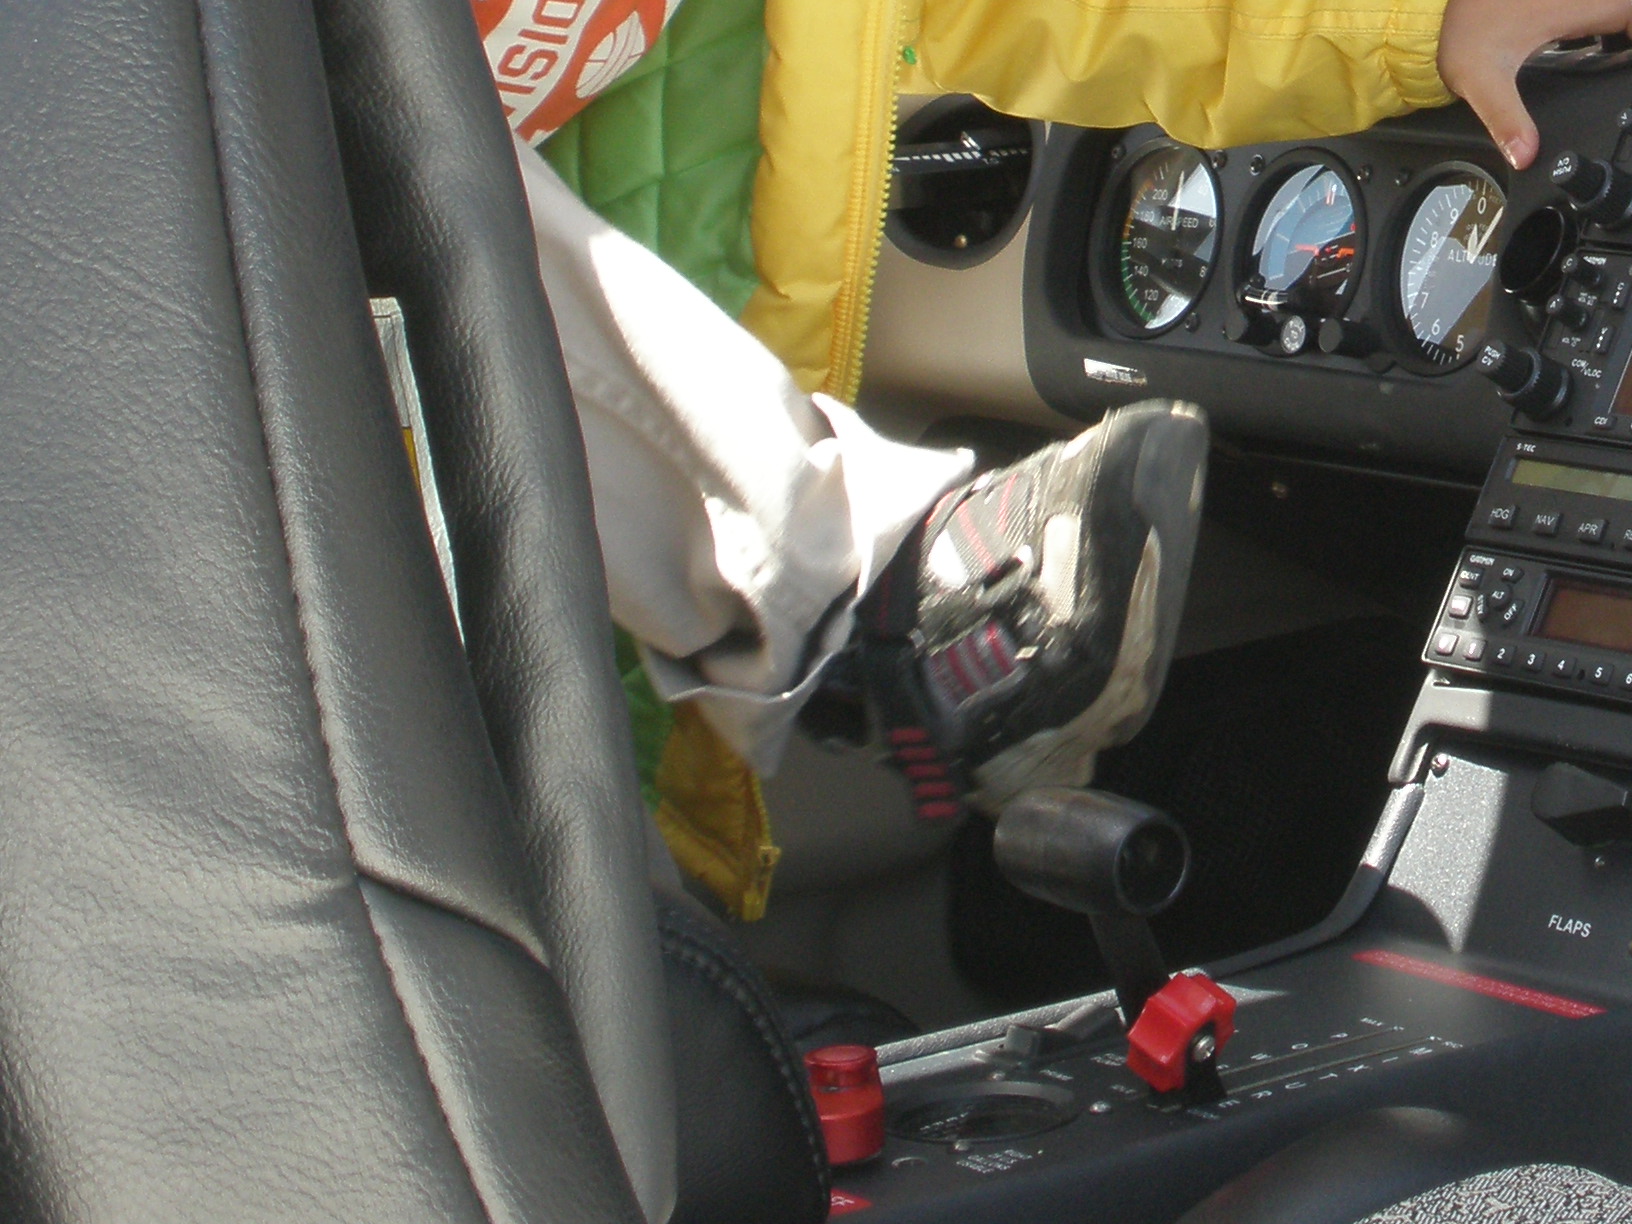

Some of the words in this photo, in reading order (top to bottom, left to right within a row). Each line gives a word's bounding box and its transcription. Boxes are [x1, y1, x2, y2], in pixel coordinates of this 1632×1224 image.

[1152, 188, 1168, 201] 200
[1477, 196, 1487, 215] 0
[1450, 207, 1459, 225] 9
[1133, 237, 1148, 249] 160
[1430, 231, 1439, 249] 8
[1133, 265, 1149, 277] 140
[1144, 289, 1159, 301] 120
[1420, 291, 1429, 309] 7
[1431, 318, 1440, 336] 6
[1455, 334, 1464, 352] 5
[1483, 345, 1501, 360] PUSH
[1594, 416, 1609, 426] CDI
[1490, 507, 1510, 521] HDG
[1535, 513, 1555, 527] NAV
[1577, 523, 1599, 536] APR
[1502, 567, 1515, 577] ON
[1491, 589, 1505, 600] ALT
[1503, 604, 1518, 621] OFF
[1497, 648, 1506, 660] 2
[1527, 653, 1536, 666] 3
[1557, 659, 1566, 671] 4
[1594, 667, 1603, 679] 5
[1548, 914, 1592, 938] FLAPS
